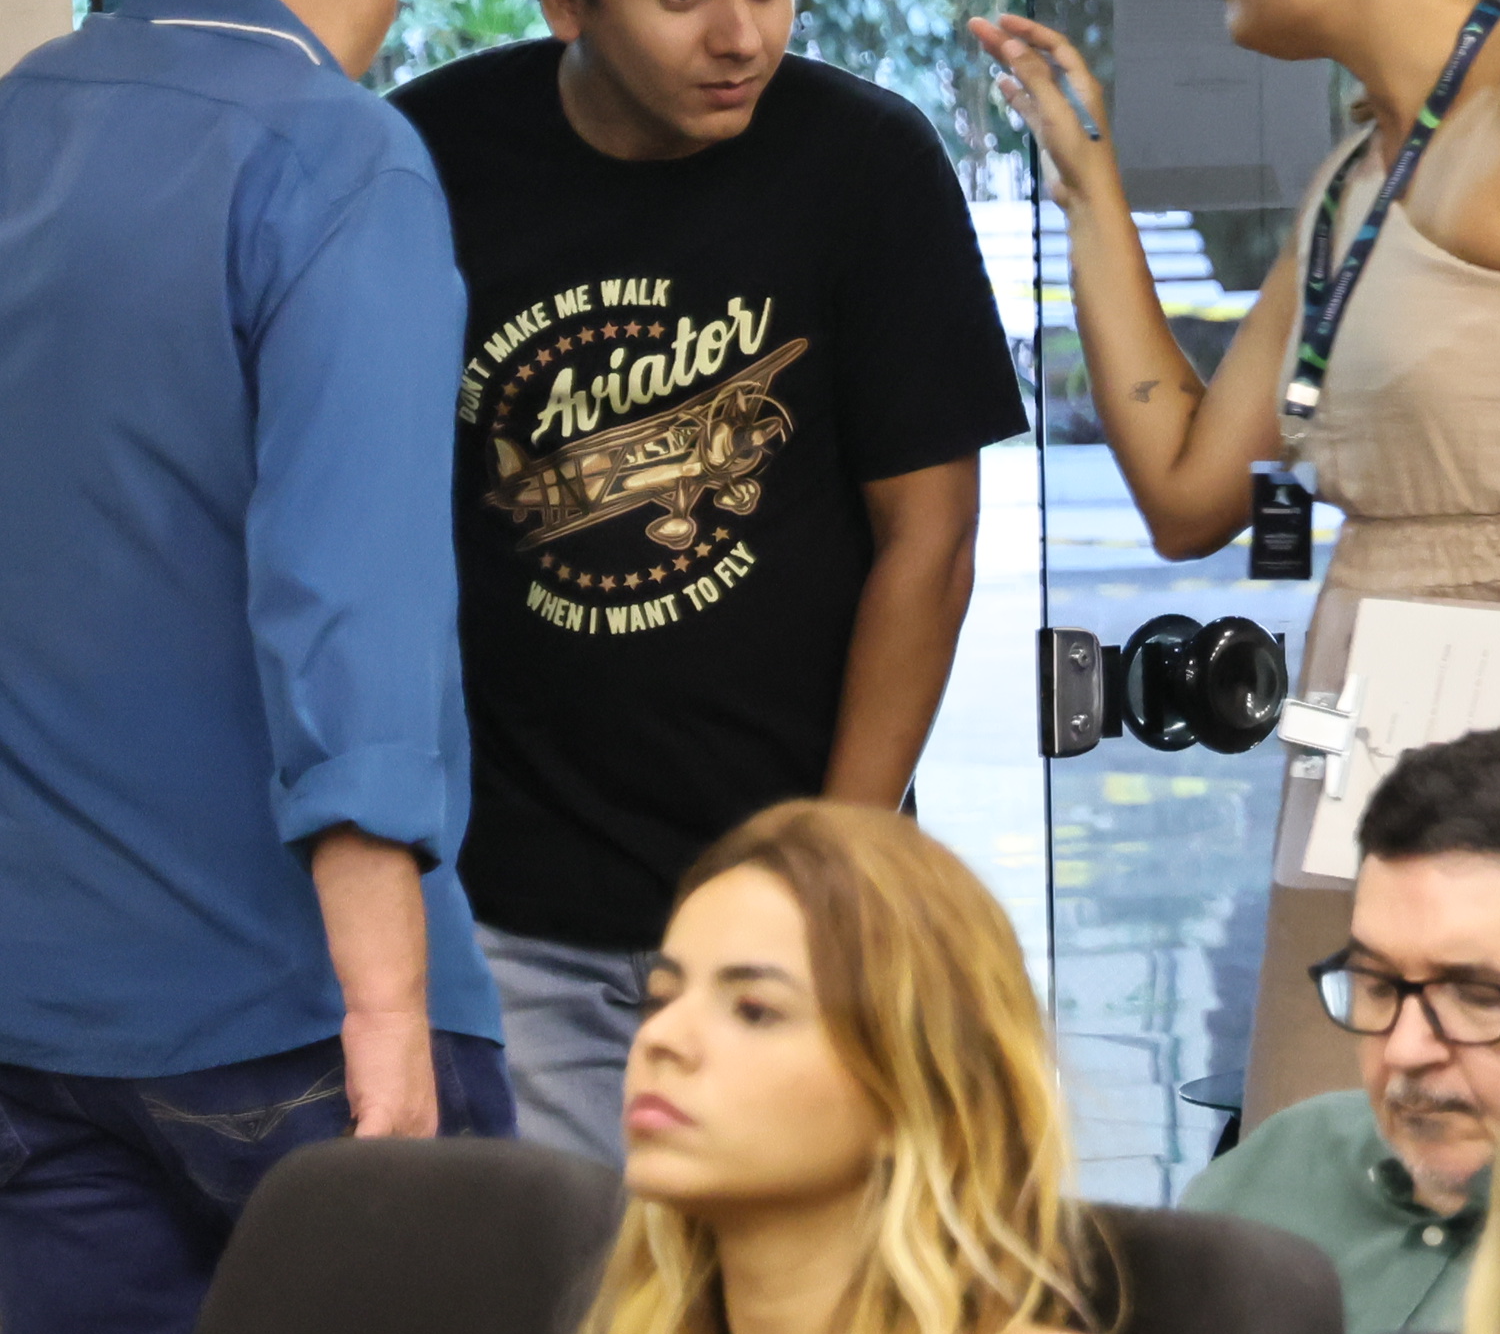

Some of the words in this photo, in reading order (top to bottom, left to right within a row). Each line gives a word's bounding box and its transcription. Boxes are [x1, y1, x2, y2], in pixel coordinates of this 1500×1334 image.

[482, 301, 552, 364] MAKE
[553, 283, 592, 320] ME
[600, 277, 671, 308] WALK
[530, 296, 772, 447] Aviator
[526, 580, 585, 633] WHEN
[589, 606, 598, 635] I
[605, 593, 680, 635] WANT
[682, 576, 720, 612] TO
[713, 540, 758, 589] FLY
